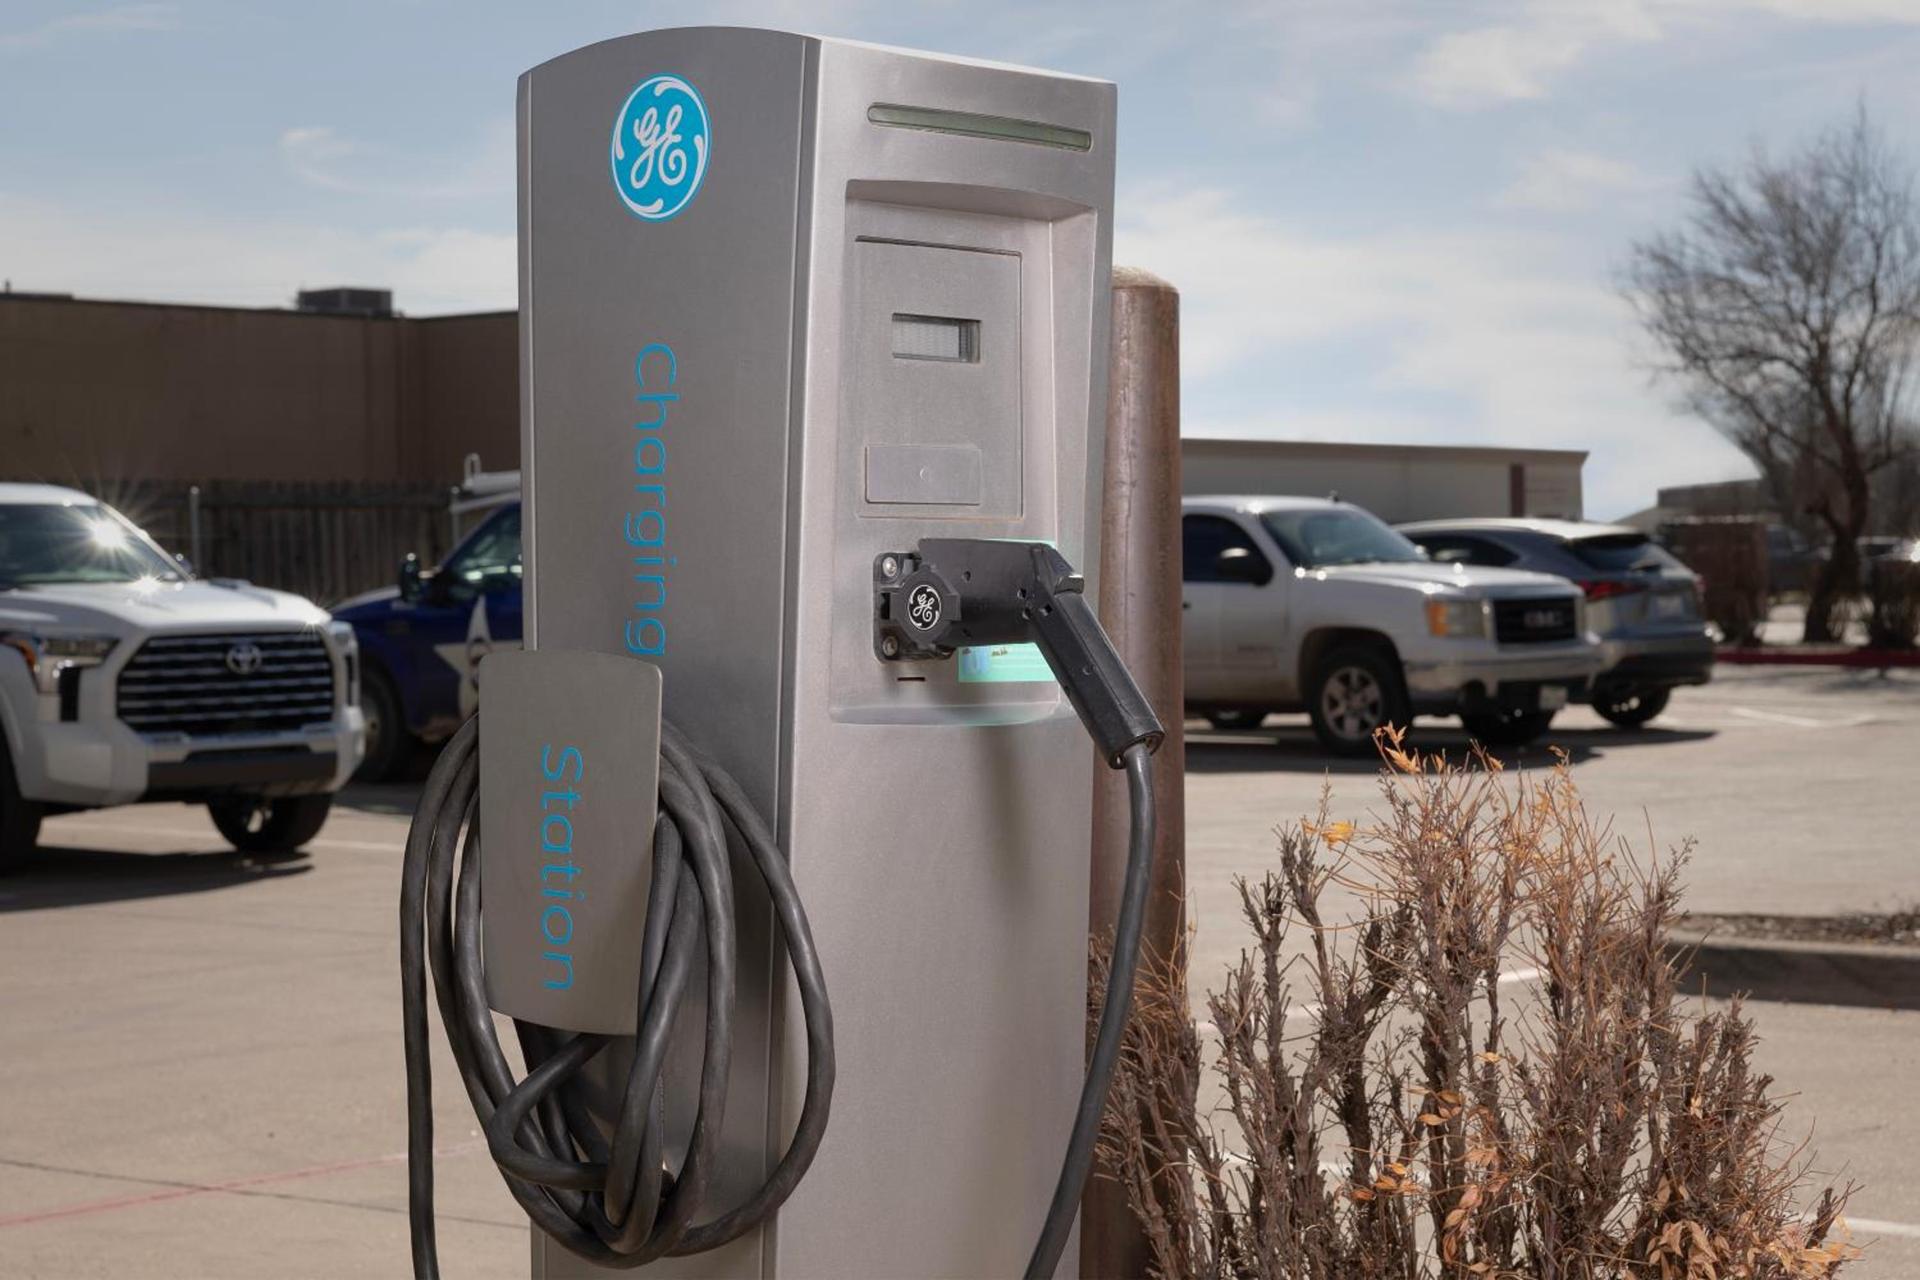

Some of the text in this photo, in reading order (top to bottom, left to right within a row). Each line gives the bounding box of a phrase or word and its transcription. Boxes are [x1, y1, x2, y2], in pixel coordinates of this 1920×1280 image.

[630, 104, 687, 190] GE
[624, 343, 680, 657] Charging
[912, 593, 935, 622] GE
[541, 744, 586, 990] Station
